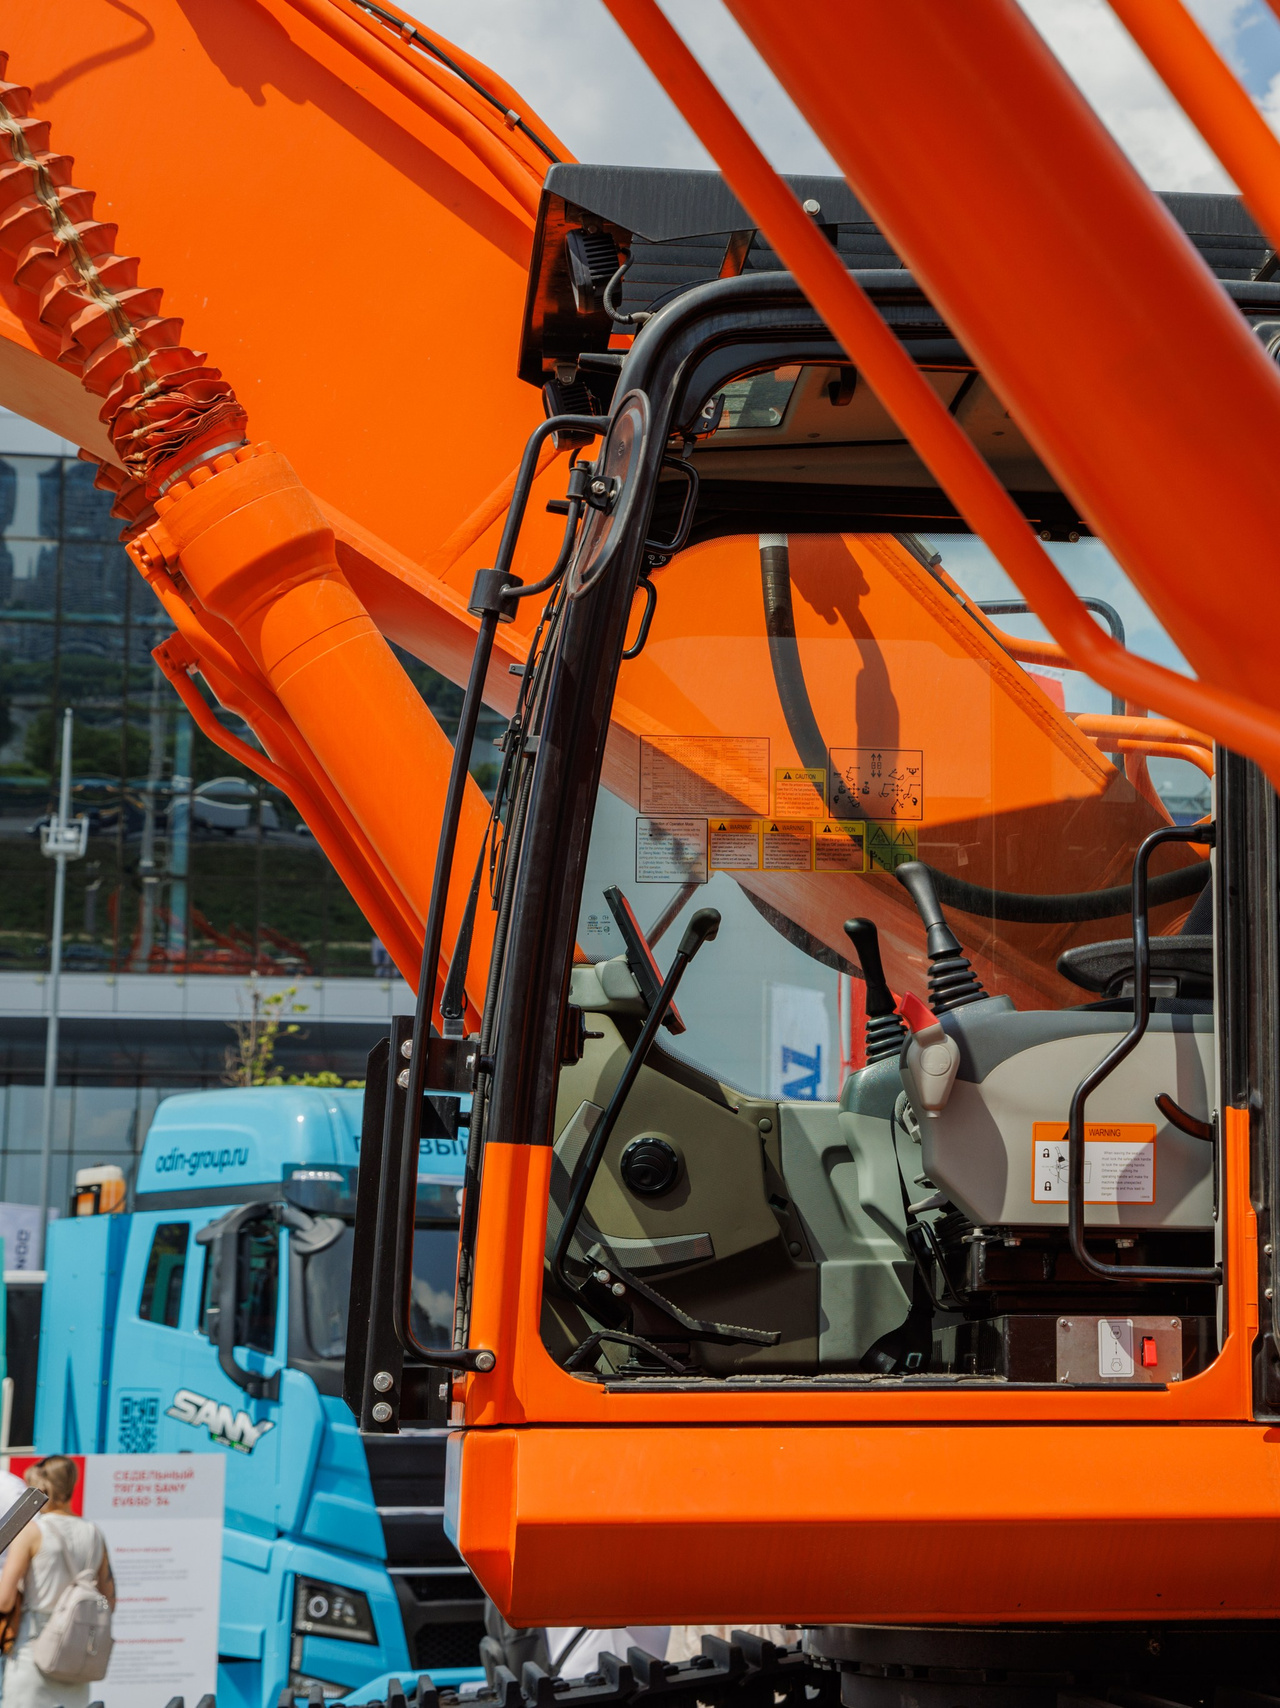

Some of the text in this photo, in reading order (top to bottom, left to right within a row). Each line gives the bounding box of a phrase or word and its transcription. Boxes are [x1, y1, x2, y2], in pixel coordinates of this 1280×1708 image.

[1089, 1129, 1121, 1137] WARNING
[155, 1146, 250, 1176] odin-group.ru
[165, 1387, 276, 1449] SANY
[113, 1467, 195, 1481] СЕДЕЛЬНЫЙ
[113, 1483, 187, 1493] ТЯГАЧ SANY
